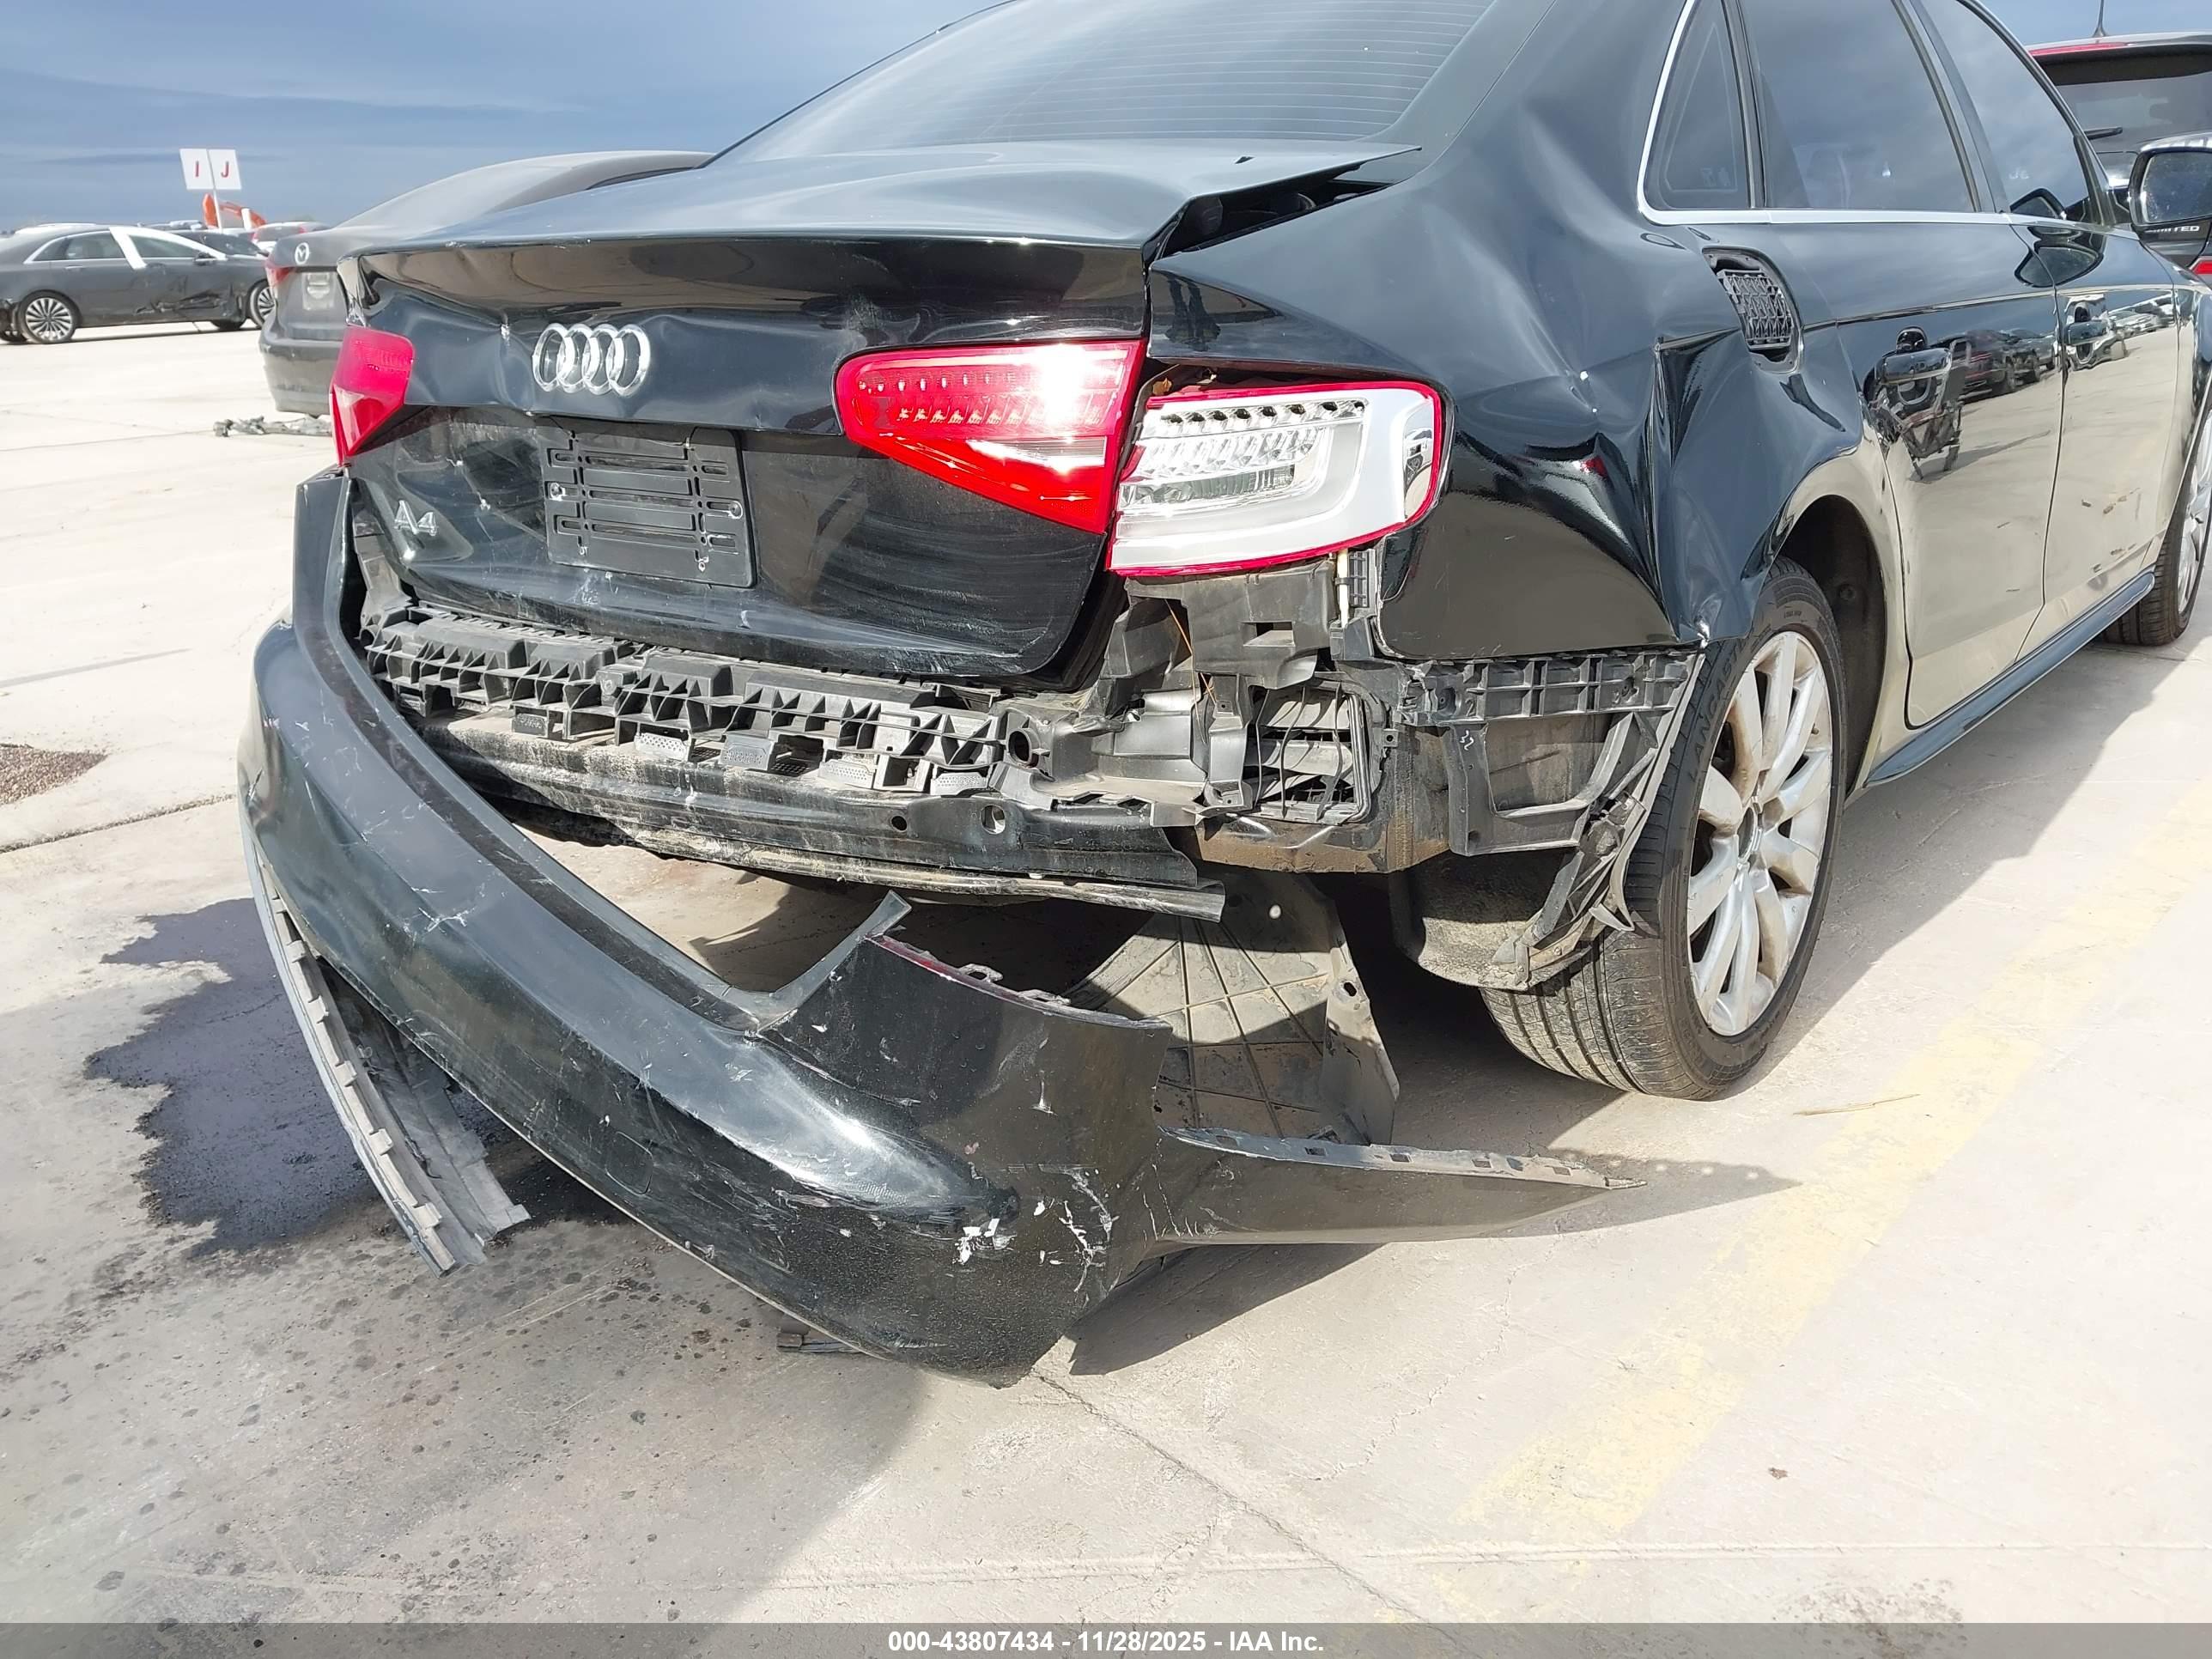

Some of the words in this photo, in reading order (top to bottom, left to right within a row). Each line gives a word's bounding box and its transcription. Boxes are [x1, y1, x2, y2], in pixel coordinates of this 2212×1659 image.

[195, 161, 199, 177] I
[221, 161, 229, 178] J
[393, 499, 438, 537] A4
